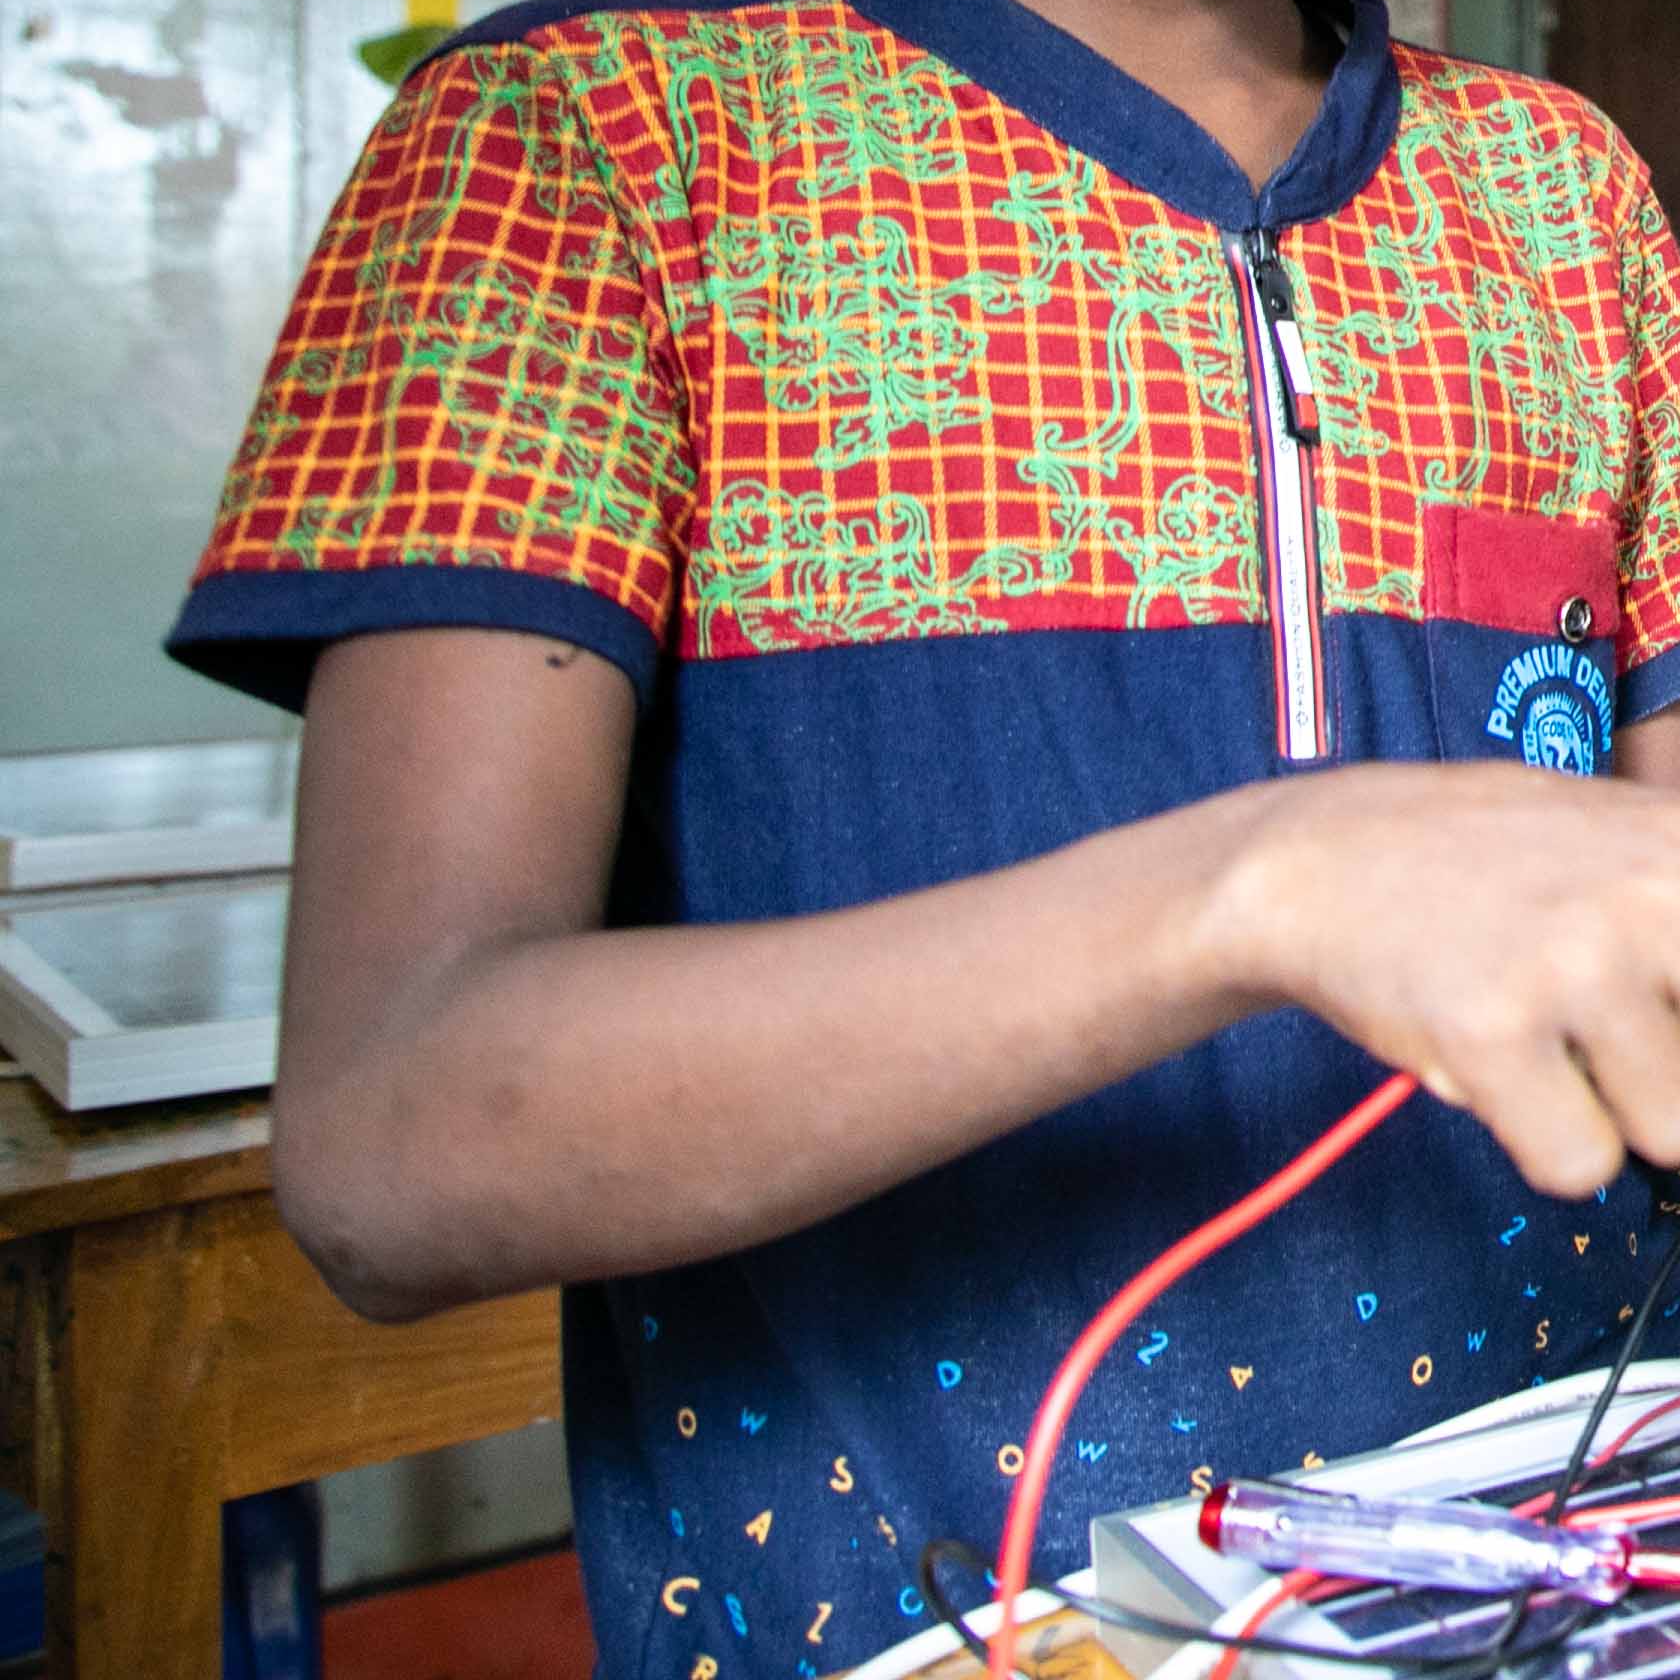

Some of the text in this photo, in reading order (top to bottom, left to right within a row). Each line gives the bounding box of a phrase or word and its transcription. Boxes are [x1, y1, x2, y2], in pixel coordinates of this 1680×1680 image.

[1486, 643, 1575, 741] PREMIUM
[1356, 1292, 1378, 1322] D
[1136, 1330, 1168, 1365] 2
[936, 1360, 962, 1390] D
[1077, 1439, 1108, 1464] W
[829, 1456, 854, 1493] S
